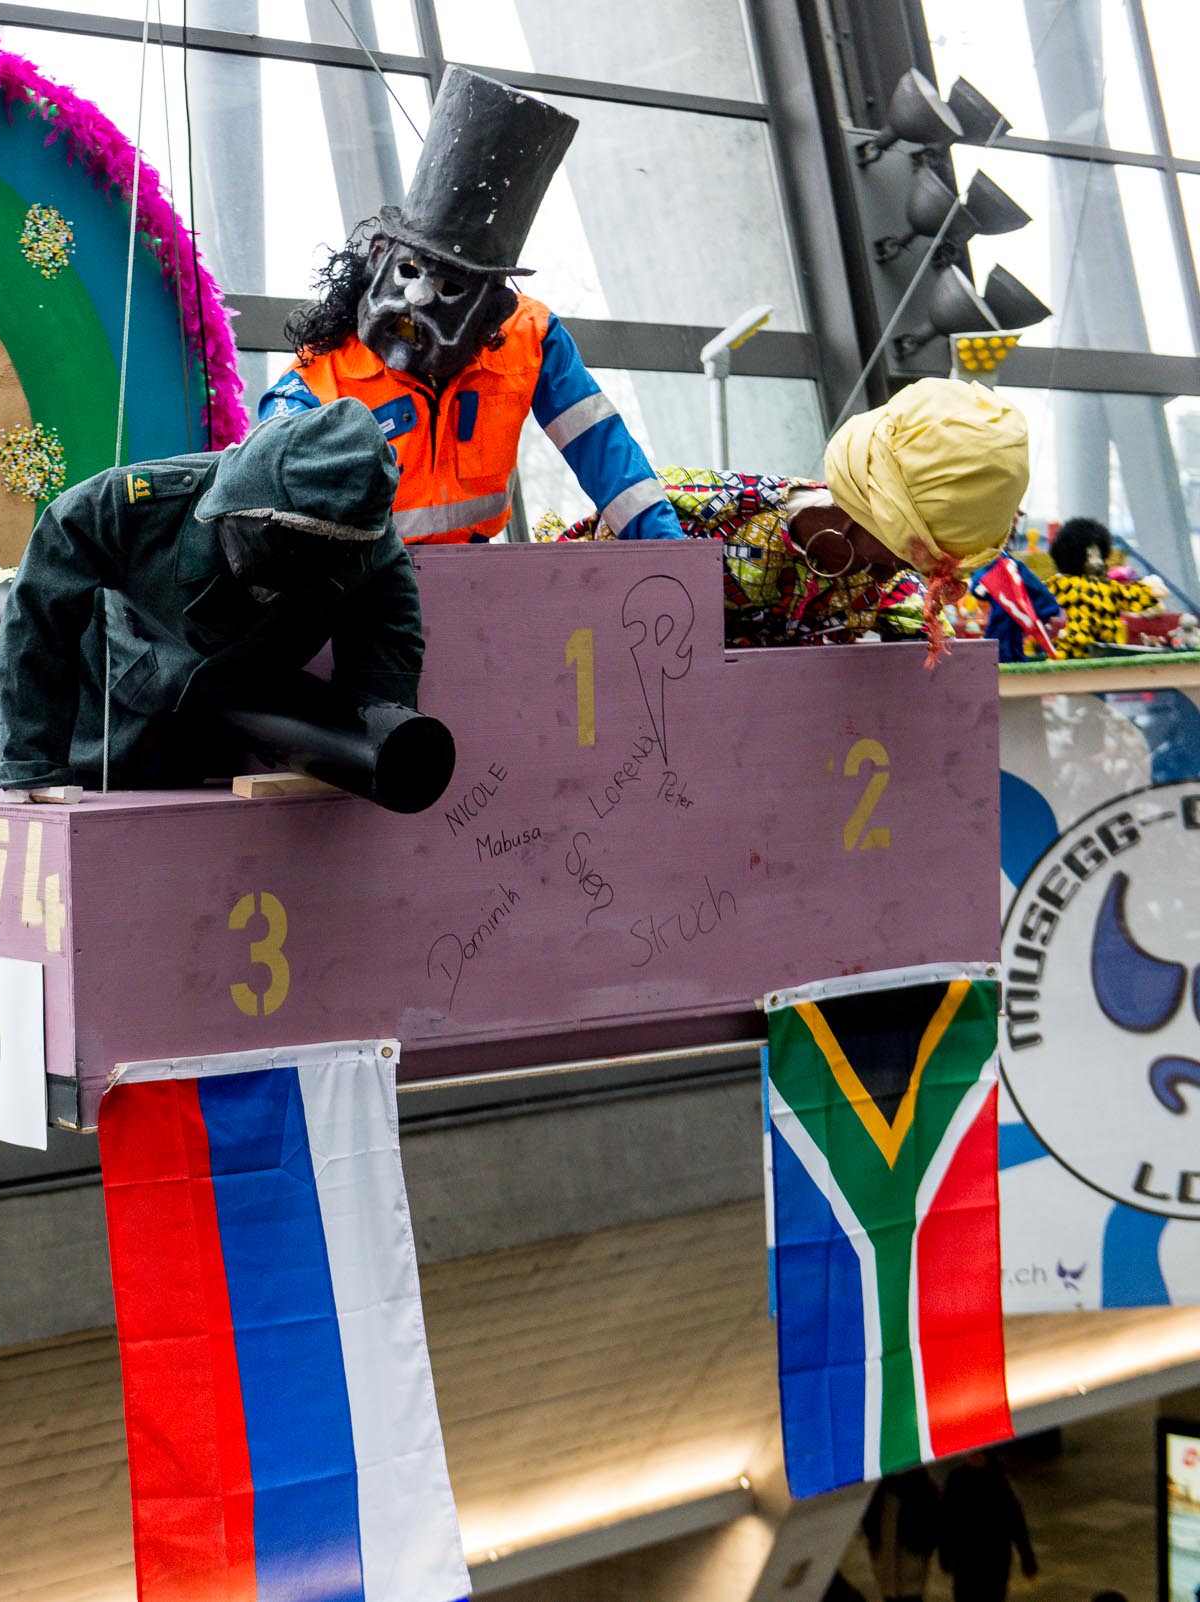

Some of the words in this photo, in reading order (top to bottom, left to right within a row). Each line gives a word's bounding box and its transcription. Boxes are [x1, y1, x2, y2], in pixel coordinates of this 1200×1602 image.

[134, 477, 151, 499] 41
[564, 627, 596, 747] 1
[445, 762, 508, 836] NICOLE
[657, 771, 695, 811] Peter
[843, 737, 892, 852] 2
[475, 826, 542, 863] Mabusa
[228, 891, 291, 1017] 3
